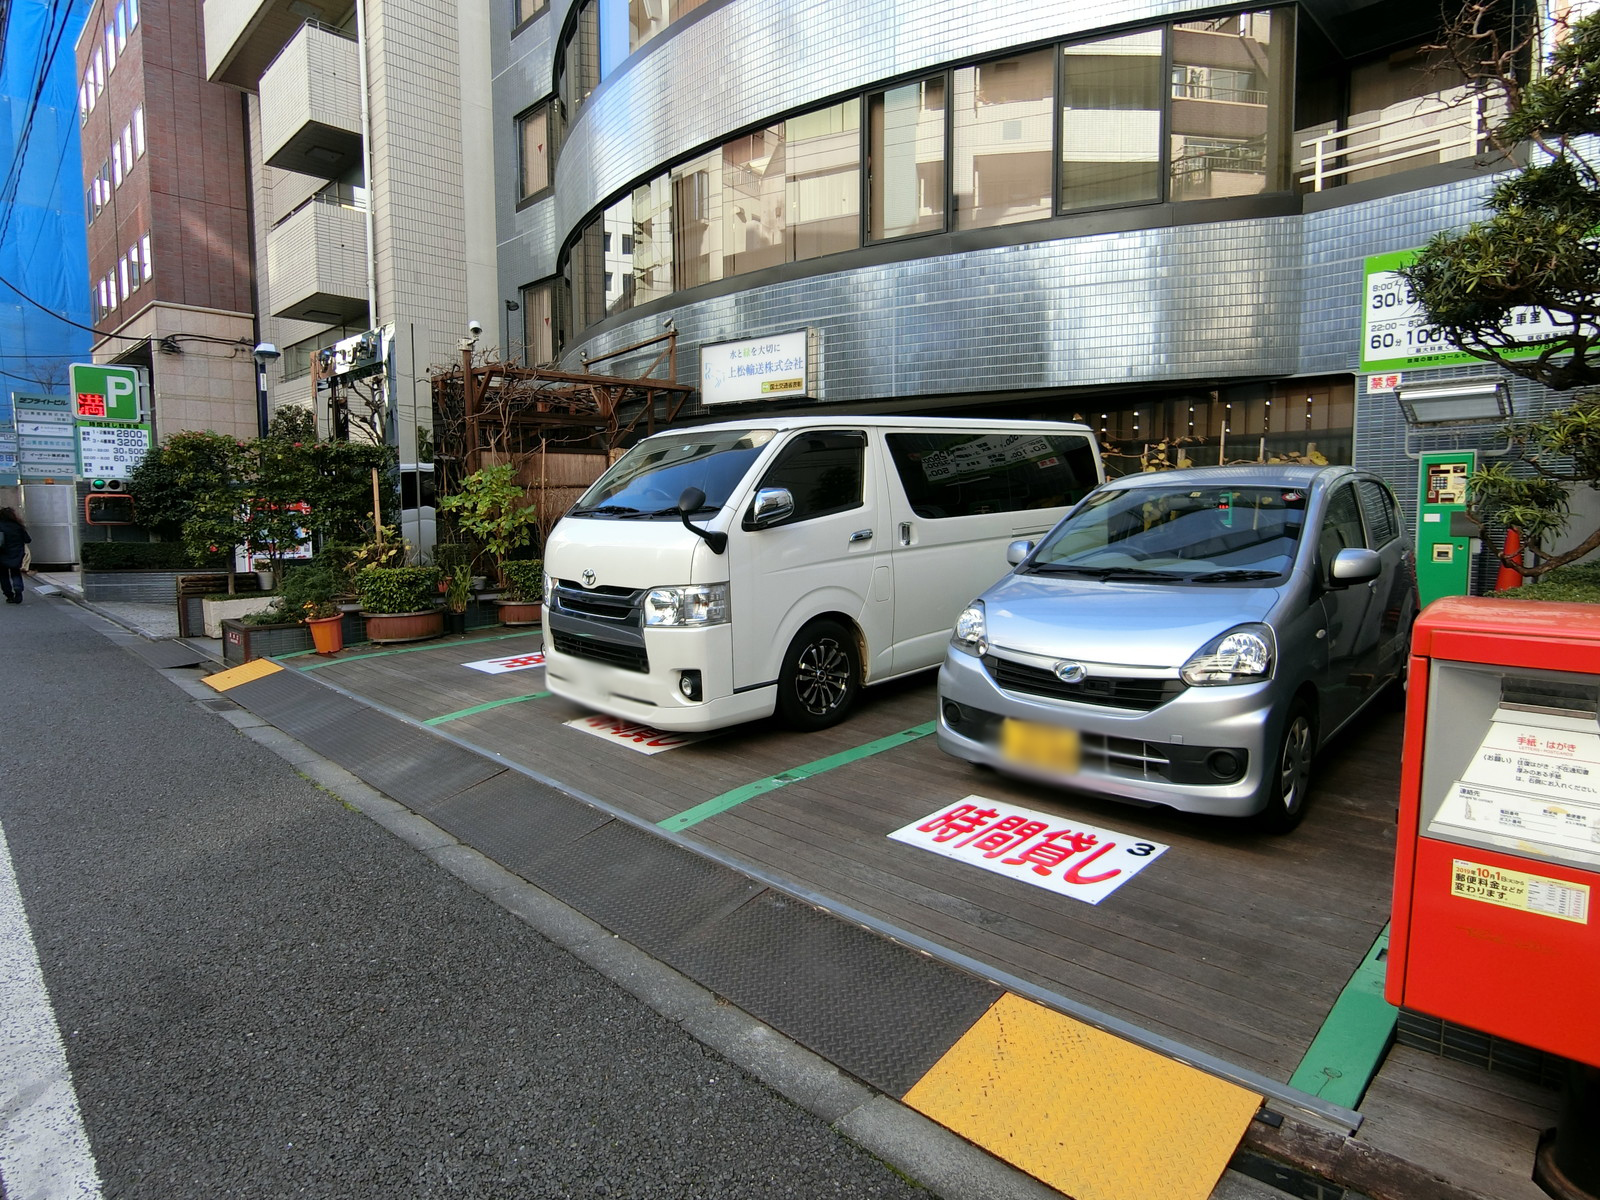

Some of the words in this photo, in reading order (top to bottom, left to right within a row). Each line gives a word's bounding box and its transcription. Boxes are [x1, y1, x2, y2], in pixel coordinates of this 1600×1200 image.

[1372, 283, 1393, 292] 8:00
[1371, 323, 1397, 332] 22:00
[729, 344, 781, 360] 水と緑を大切に
[728, 356, 804, 379] 上松輸送株式会社
[1370, 374, 1398, 389] 禁煙
[106, 375, 133, 408] P
[77, 394, 105, 417] 満
[1517, 736, 1577, 753] 手紙・はがき
[915, 803, 1122, 885] 時間貸し
[1126, 842, 1156, 857] 3
[1455, 873, 1524, 895] 郵便料金などが
